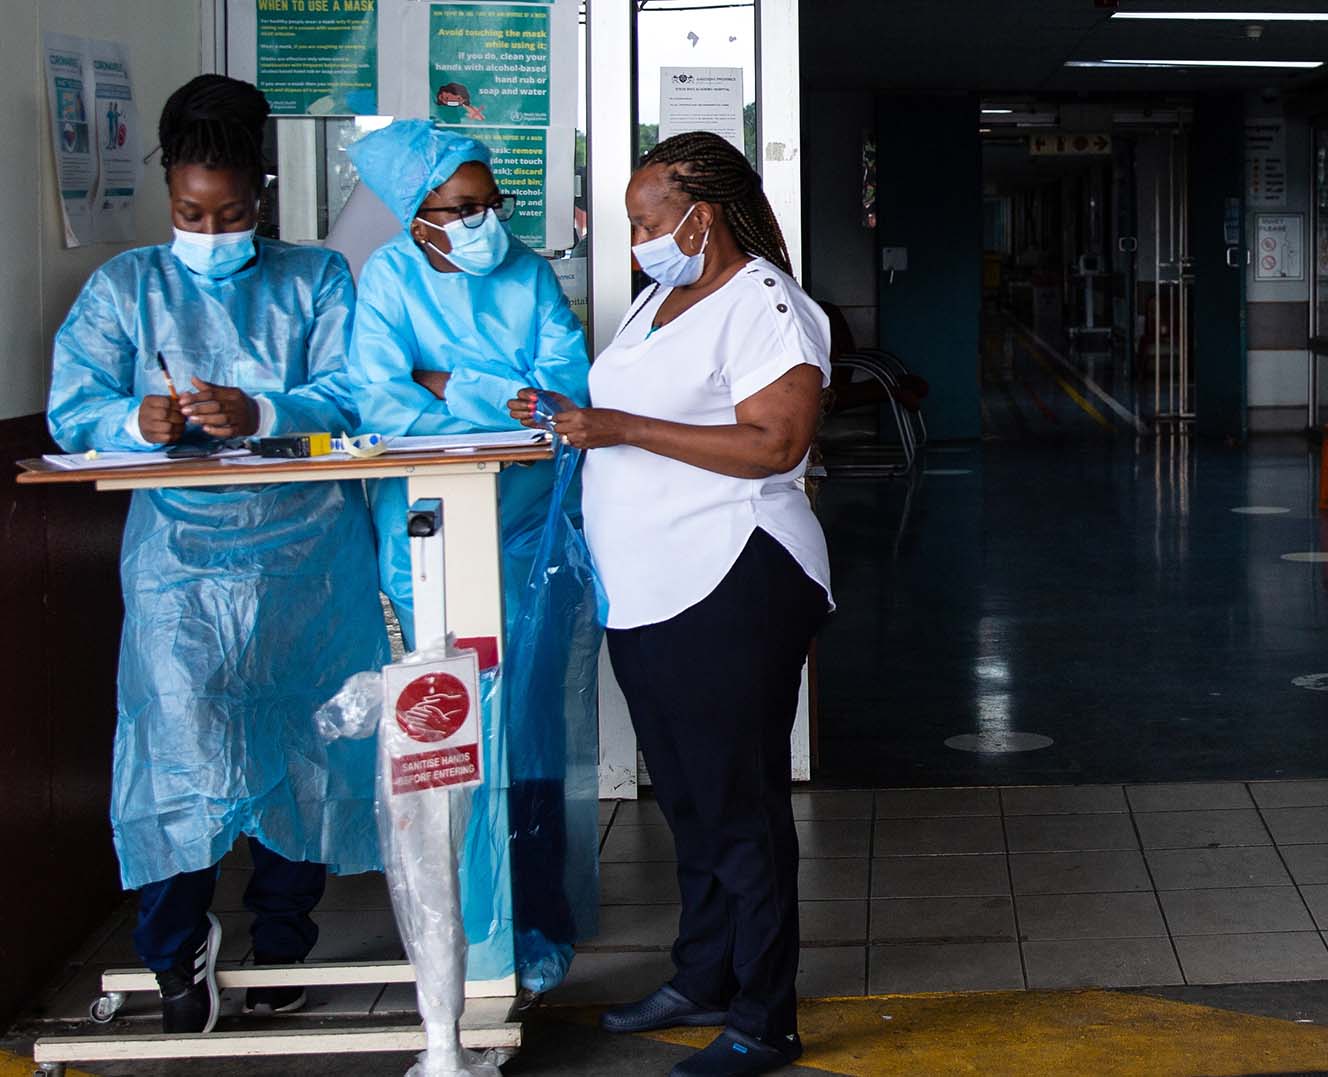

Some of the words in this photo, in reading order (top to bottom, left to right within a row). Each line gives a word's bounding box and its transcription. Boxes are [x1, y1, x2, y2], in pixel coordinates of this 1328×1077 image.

[259, 0, 288, 11] WHEN
[293, 0, 304, 11] TO
[308, 0, 328, 11] USE
[333, 0, 341, 11] A
[344, 0, 374, 11] MASK
[438, 28, 464, 36] Avoid
[465, 29, 503, 38] touching
[506, 29, 521, 37] the
[511, 41, 535, 51] using
[467, 53, 484, 62] you
[485, 52, 498, 61] do,
[526, 54, 546, 62] your
[435, 63, 462, 71] hands
[464, 63, 484, 71] with
[486, 64, 546, 72] alcohol-based
[495, 76, 518, 84] hand
[479, 88, 500, 96] soap
[501, 87, 519, 95] and
[520, 157, 543, 165] touch
[402, 757, 440, 771] SANITISE
[441, 752, 470, 764] HANDS
[433, 763, 476, 779] ENTERING
